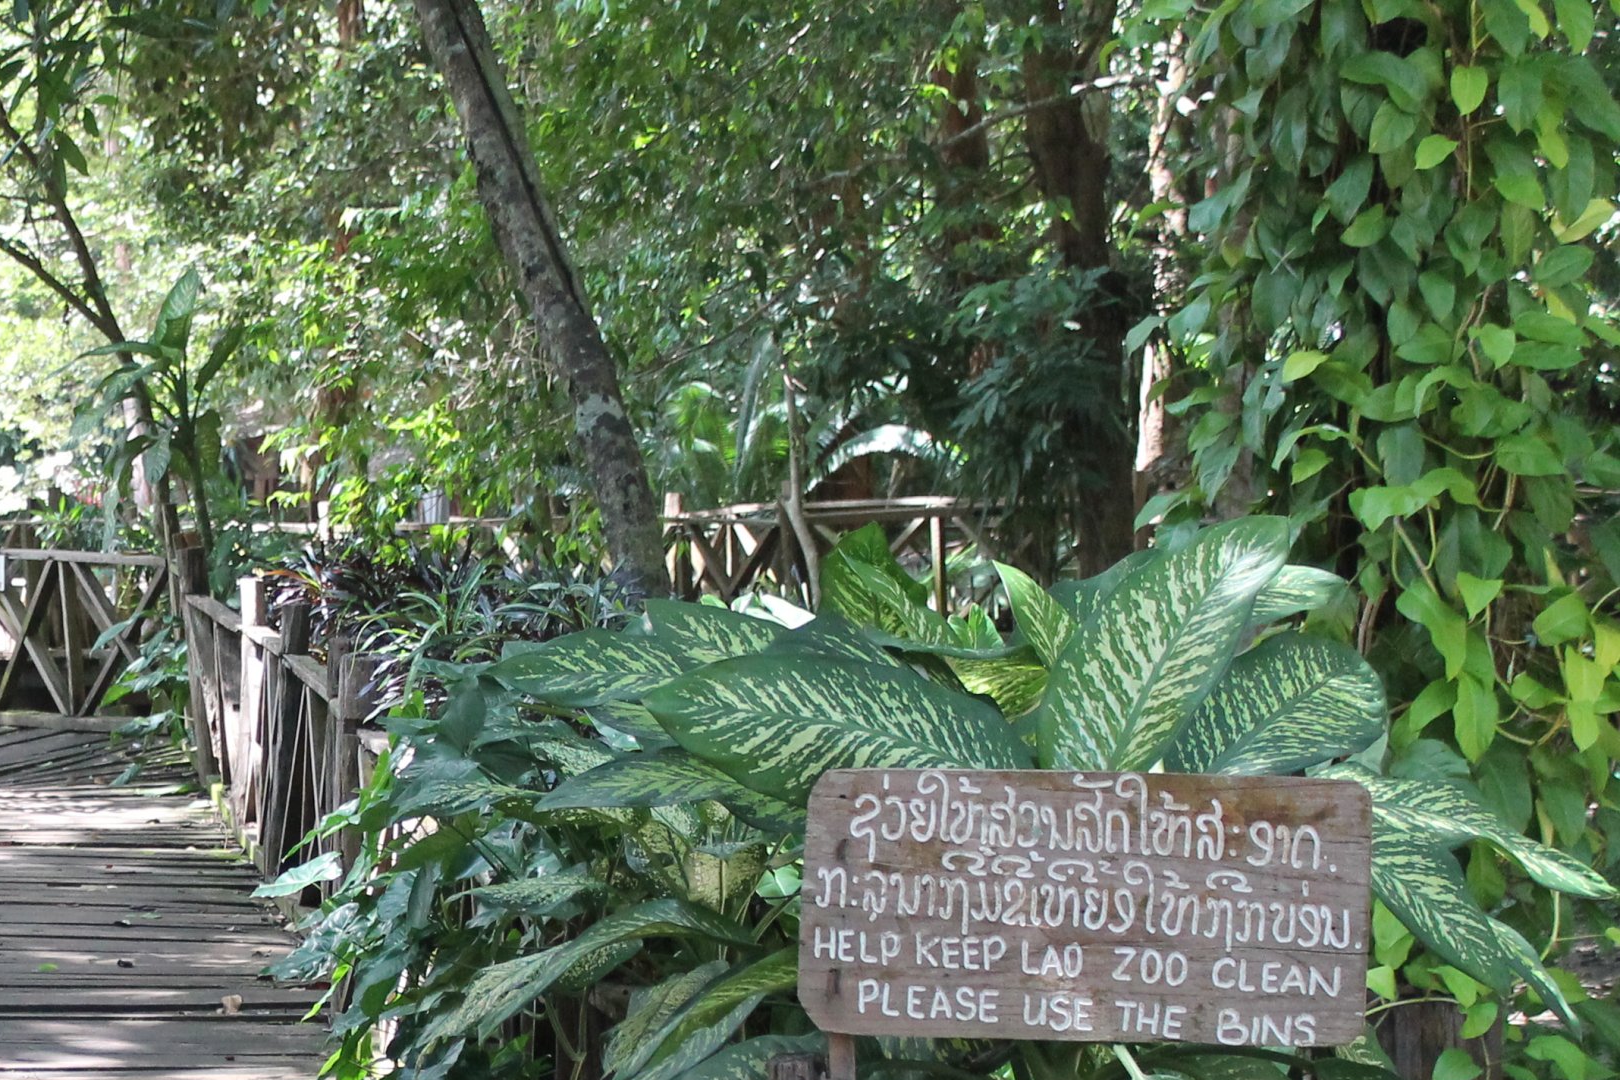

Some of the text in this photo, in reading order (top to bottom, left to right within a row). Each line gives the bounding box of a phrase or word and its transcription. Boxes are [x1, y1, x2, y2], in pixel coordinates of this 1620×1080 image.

[813, 926, 1342, 999] HELP KEEP LAO ZOO CLEAN
[857, 978, 1317, 1047] PLEASE USE THE BINS
